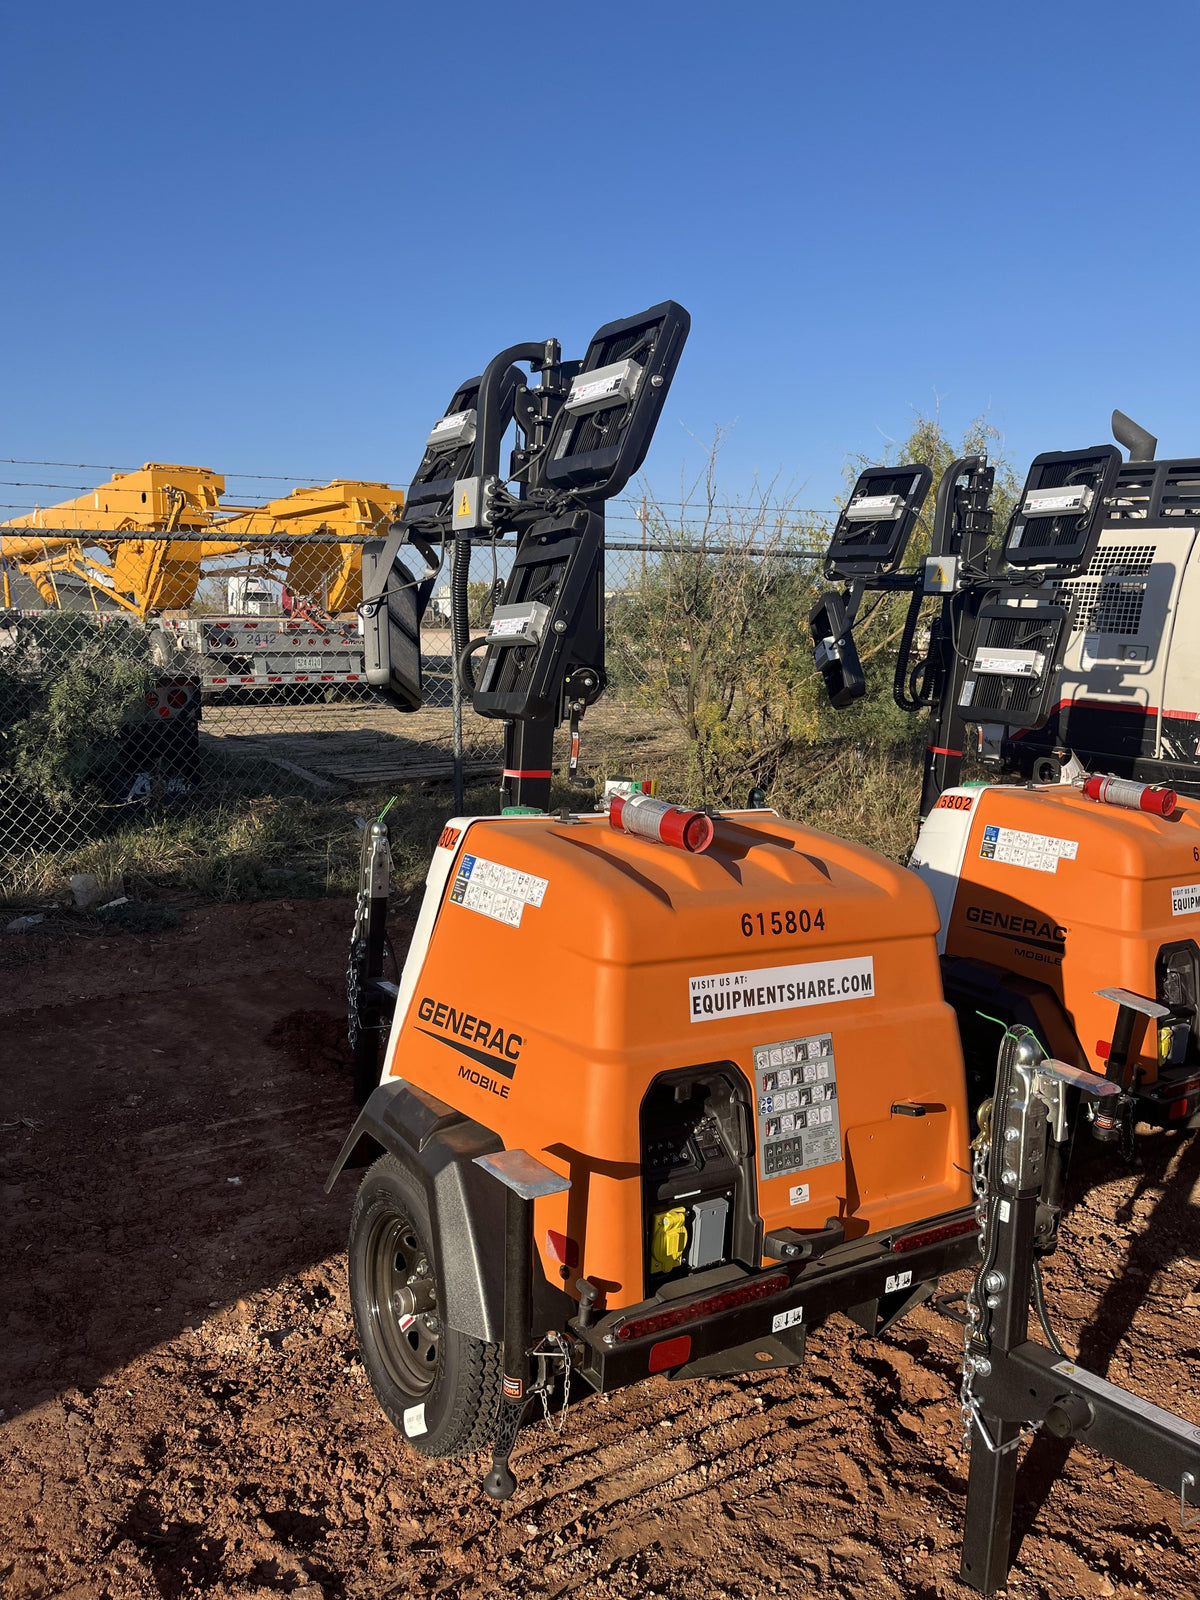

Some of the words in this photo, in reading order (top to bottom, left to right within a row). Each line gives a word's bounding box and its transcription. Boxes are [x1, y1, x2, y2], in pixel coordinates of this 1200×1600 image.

[246, 633, 276, 645] 2442
[741, 908, 825, 938] 615804
[966, 906, 1068, 943] GENERAC
[1014, 947, 1062, 967] MOBILE
[691, 979, 716, 991] VISIT
[719, 977, 731, 987] US
[734, 975, 748, 985] AT:
[692, 973, 872, 1016] EQUIPMENTSHARE.COM
[418, 997, 523, 1060] GENERAC
[457, 1065, 510, 1099] MOBILE
